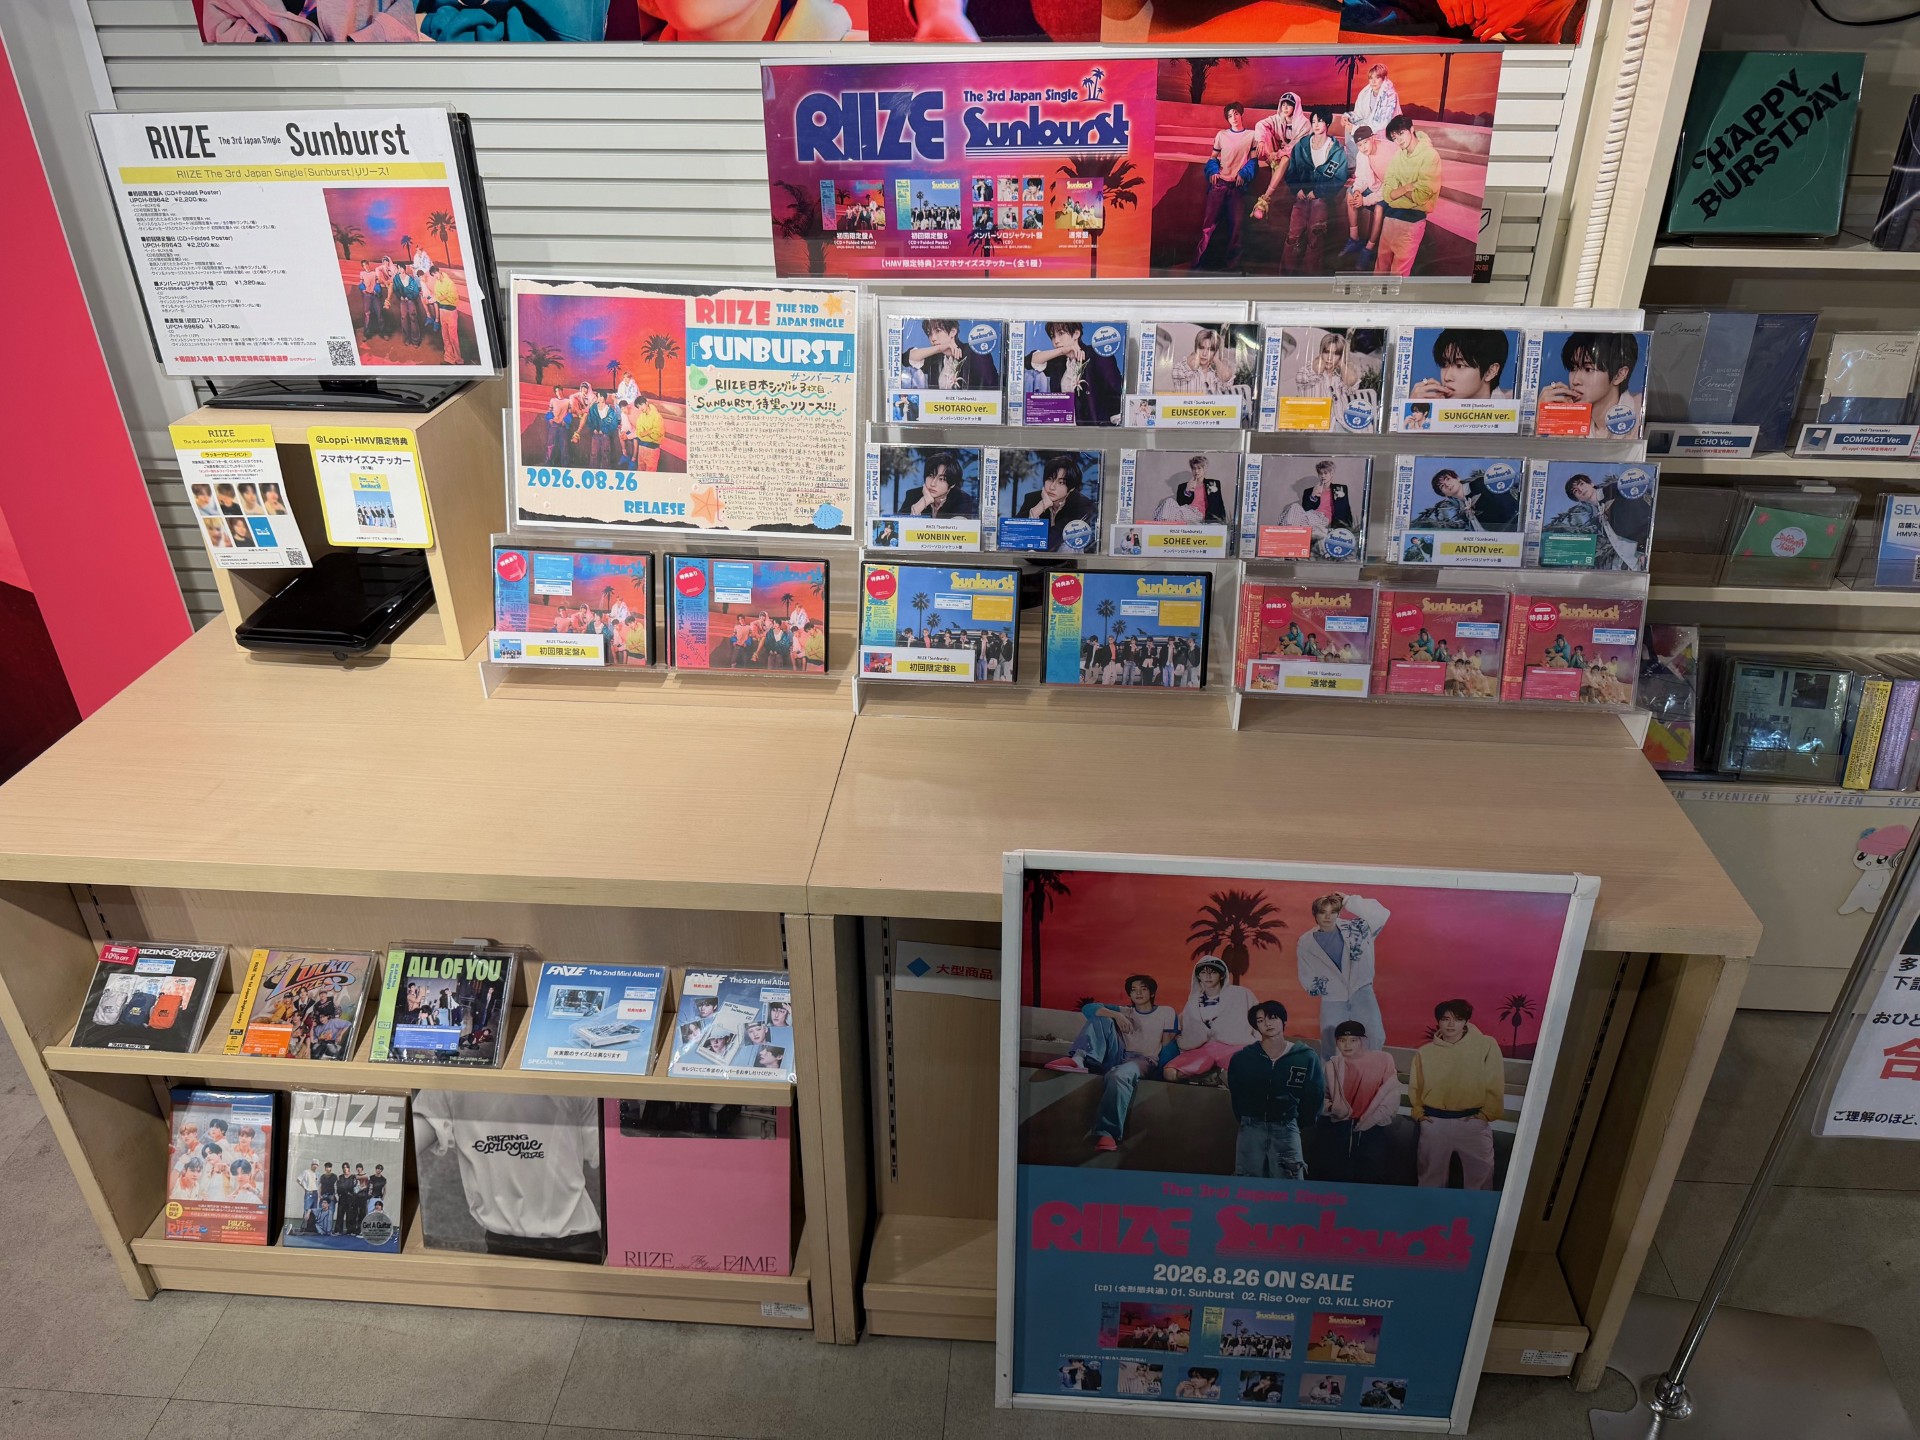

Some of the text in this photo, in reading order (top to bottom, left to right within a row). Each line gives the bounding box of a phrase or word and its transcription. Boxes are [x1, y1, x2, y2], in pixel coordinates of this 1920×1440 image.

[964, 88, 1078, 104] The 3rd Japan Single
[963, 103, 1129, 146] Sunburst
[1691, 67, 1809, 173] HAPPY
[795, 91, 944, 162] RIIZE
[145, 122, 410, 159] RIIZE The 3rd Japan Single Sunburst
[1692, 71, 1852, 223] BURSTDAY
[176, 169, 203, 179] RIIZE
[204, 169, 223, 179] The
[225, 168, 242, 179] 3rd
[243, 168, 272, 180] Japan
[836, 232, 874, 240] 初回限定盤A
[911, 232, 948, 240] 初回限定盤B
[973, 231, 1043, 240] メンバーソロジャケット盤
[1068, 231, 1089, 239] 通常盤
[695, 298, 819, 326] RIIZE THE 3RD
[776, 316, 845, 328] JAPAN SINGLE
[791, 372, 852, 384] サンバースト
[973, 405, 989, 413] ver.
[1171, 408, 1227, 417] EUNSEOK ver.
[1444, 412, 1493, 420] SUNGCHAN
[207, 429, 236, 438] RIIZE
[1842, 435, 1901, 444] COMPACT Ver.
[1693, 438, 1734, 446] ECHO Ver.
[321, 454, 411, 465] スマホサイズステッカー
[526, 468, 638, 491] 2026.08.26
[624, 500, 686, 516] RELAESE
[916, 533, 950, 541] WONBIN
[1454, 546, 1486, 554] ANTON
[499, 555, 518, 567] 特典あり
[679, 571, 698, 580] 特典あり
[870, 574, 890, 582] 特典あり
[950, 571, 1015, 591] Sunburst
[1055, 579, 1075, 588] 特典あり
[1136, 578, 1203, 596] Sunburst
[1290, 591, 1352, 608] Sunburst
[1421, 597, 1484, 614] Sunburst
[1395, 609, 1417, 618] 特典あり
[1558, 602, 1620, 619] Sunburst
[1529, 613, 1556, 621] 特典あり
[1252, 612, 1260, 643] サンバースト
[539, 647, 586, 656] 初回限定盤A
[909, 663, 957, 673] 初回限定盤B
[1310, 679, 1337, 688] 通常盤
[1701, 790, 1770, 803] SEVENTEEN
[1794, 794, 1864, 806] SEVENTEEN
[104, 952, 120, 960] 10%
[171, 948, 217, 962] Epilogue
[406, 956, 440, 978] ALL
[440, 957, 465, 980] OF
[464, 958, 503, 982] YOU
[935, 963, 994, 981] 大型商品
[729, 976, 743, 984] The
[553, 1050, 621, 1059] ※実際のサイズとは異なります
[289, 1093, 406, 1138] RIIZE
[472, 1139, 543, 1157] Epilogue
[520, 1151, 545, 1159] RIIZE
[1161, 1181, 1191, 1198] The
[1197, 1184, 1228, 1199] 3rd
[362, 1221, 392, 1229] Get A Guitar
[1032, 1201, 1476, 1266] RIIZE Sunburst
[624, 1250, 778, 1273] RIIZE FAME
[1152, 1263, 1354, 1291] 2026.8.26 ON SALE
[1093, 1283, 1394, 1308] [CD] (全形態共通) 01. Sunburst 02. Rise Over 03. KILL SHOT
[1256, 1311, 1295, 1321] Sunburst
[1328, 1315, 1366, 1326] Sunburst
